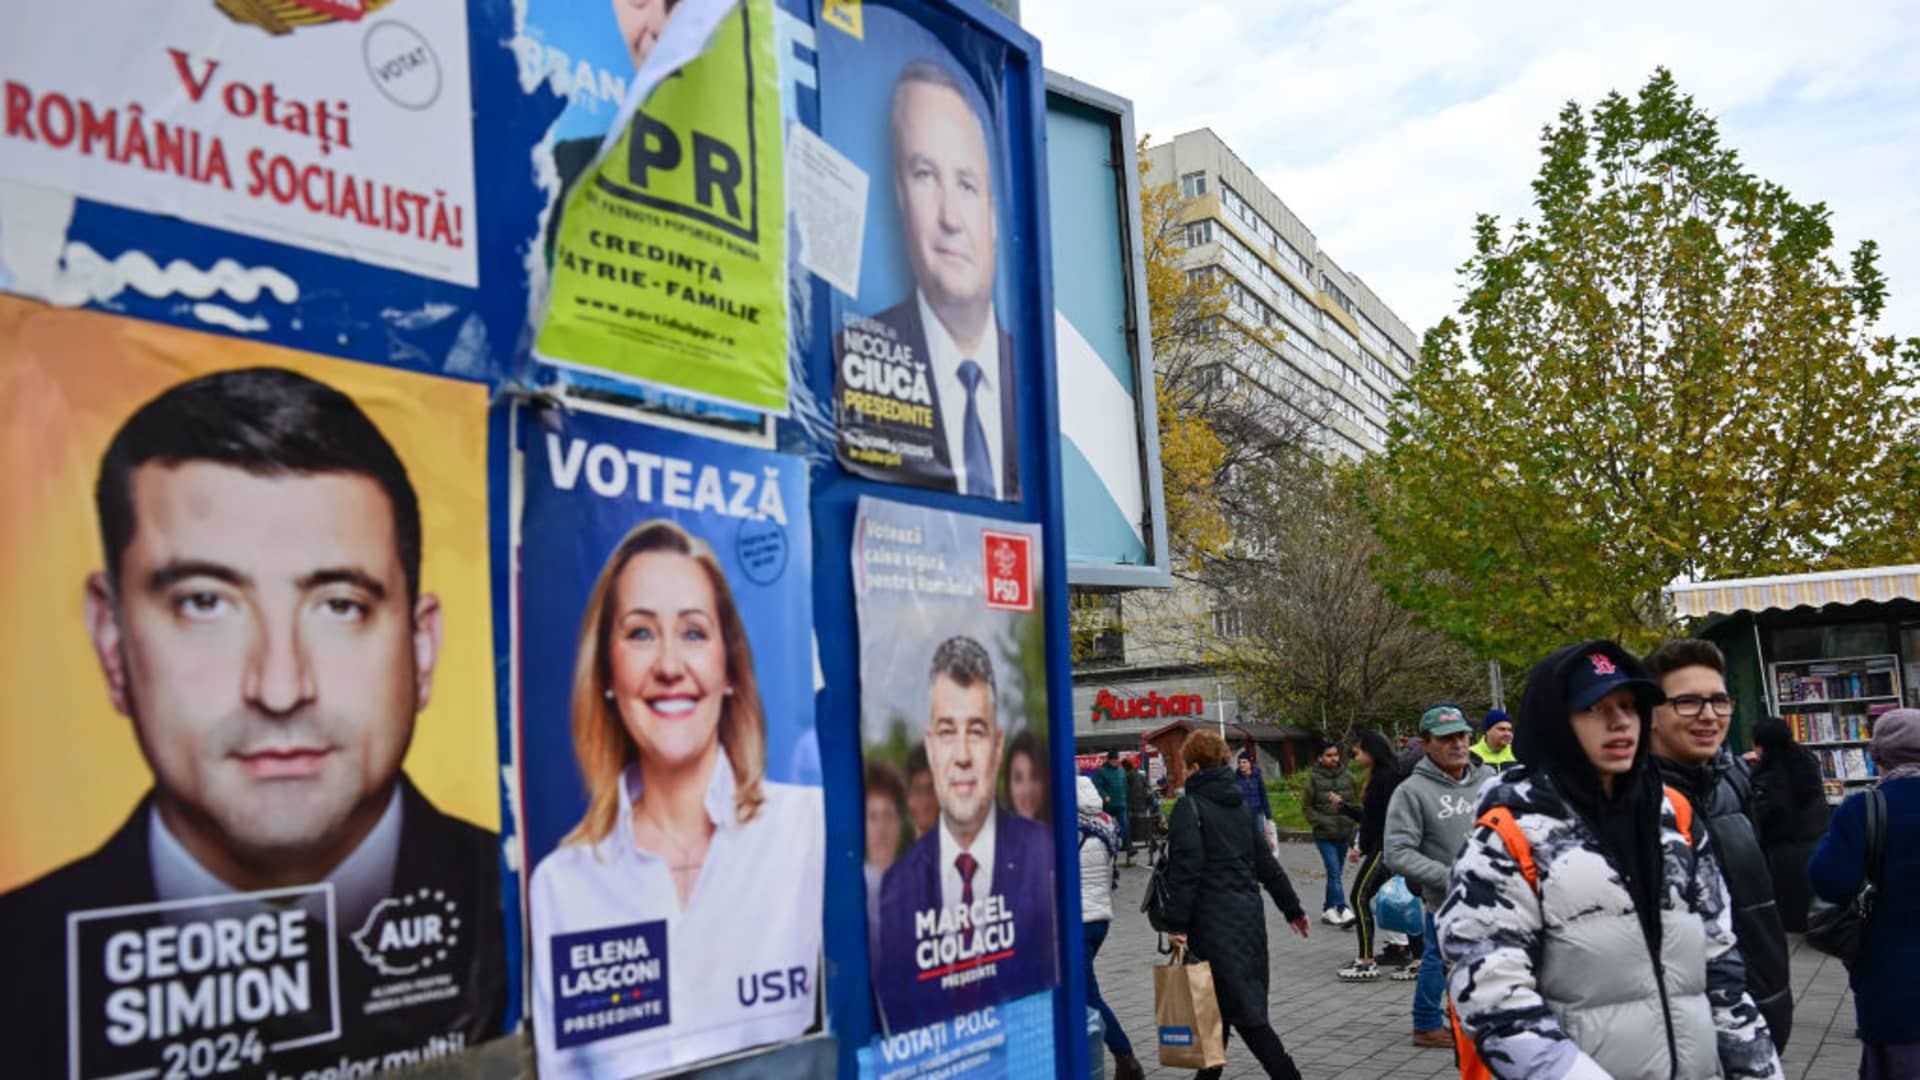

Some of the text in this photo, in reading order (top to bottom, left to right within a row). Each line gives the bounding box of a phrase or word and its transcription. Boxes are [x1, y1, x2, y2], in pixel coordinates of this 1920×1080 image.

[375, 47, 427, 81] VOTAT
[167, 48, 352, 155] Votați
[3, 79, 233, 190] ROMÂNIA
[247, 147, 464, 248] SOCIALISTĂ!
[844, 329, 912, 367] NICOLAE
[842, 353, 933, 405] CIUCĂ
[545, 432, 788, 526] VOTEAZĂ
[992, 577, 1020, 602] PSD
[1091, 689, 1204, 721] Auchan
[378, 914, 443, 951] AUR
[915, 894, 1013, 940] MARCEL
[104, 909, 308, 984] GEORGE
[570, 935, 649, 970] ELENA
[915, 921, 1015, 970] CIOLACU
[560, 958, 661, 998] LASCONI
[738, 965, 809, 1007] USR
[104, 961, 311, 1046] SIMION
[162, 1028, 265, 1080] 2024
